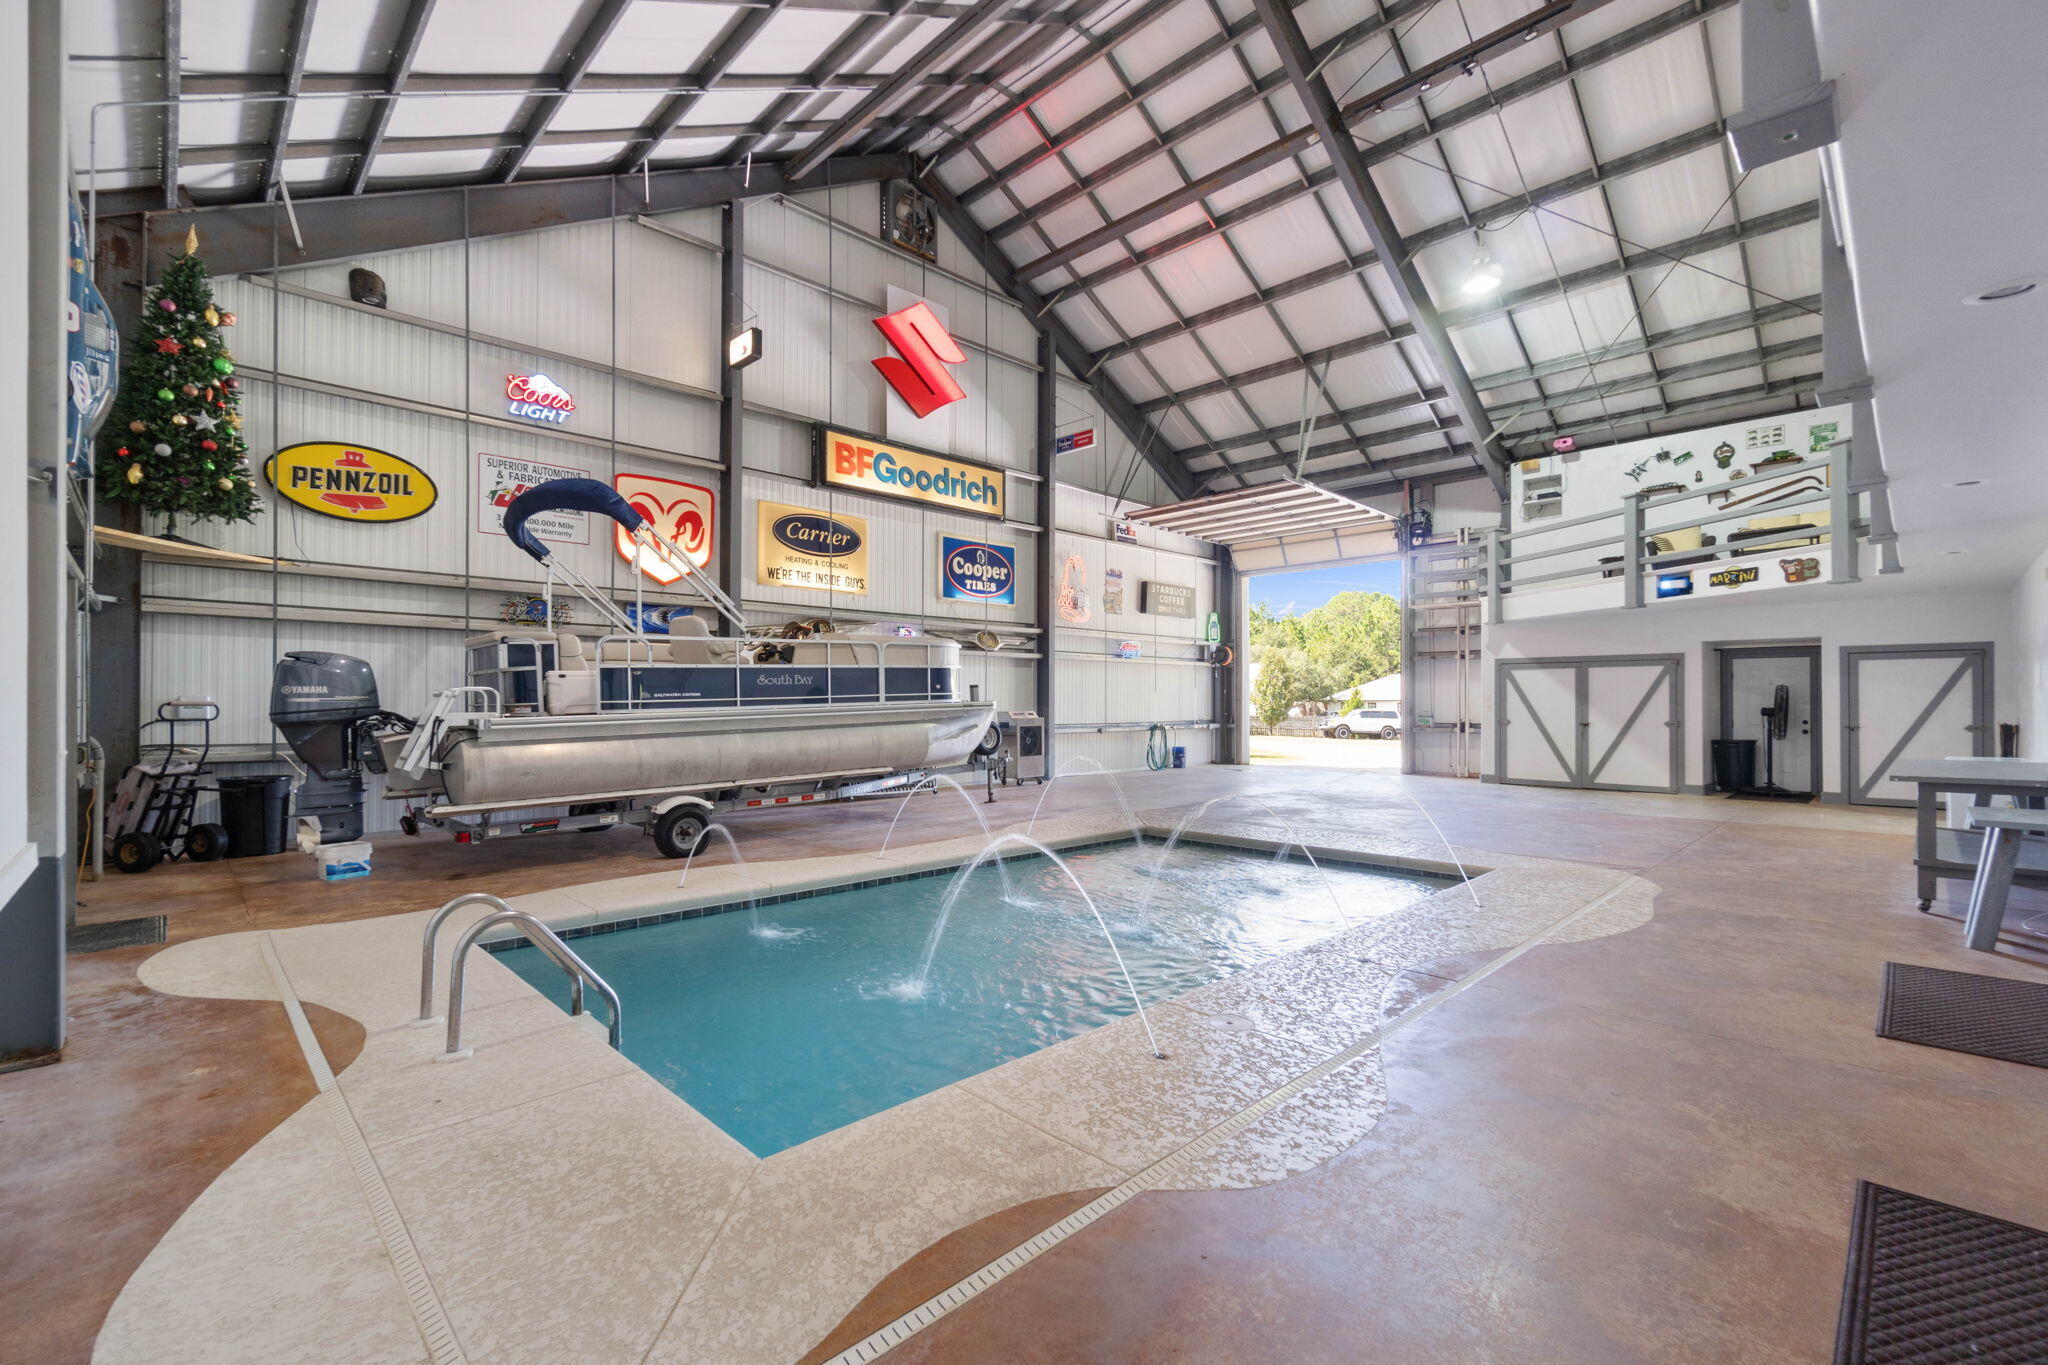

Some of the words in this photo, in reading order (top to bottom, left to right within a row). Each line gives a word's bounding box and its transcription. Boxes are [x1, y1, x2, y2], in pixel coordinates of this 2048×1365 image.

[507, 373, 576, 411] Coors
[509, 401, 572, 423] LIGHT
[487, 457, 529, 474] SUPERIOR
[532, 465, 582, 479] AUTOMOTIVE
[496, 470, 504, 479] &
[835, 440, 998, 507] BFGoodrich
[291, 465, 416, 496] PENNZOIL
[558, 521, 575, 530] Mile
[1116, 523, 1137, 537] FedEx
[541, 528, 573, 538] Warranty
[786, 522, 851, 546] Carrier
[785, 556, 813, 566] HEATING
[821, 560, 849, 570] COOLING
[952, 556, 1008, 581] Cooper
[767, 566, 793, 581] WE'RE
[796, 570, 812, 583] THE
[815, 573, 841, 587] INSDE
[964, 579, 997, 592] TIRES
[1151, 584, 1192, 597] STARBUCKS
[1159, 595, 1185, 606] COFFEE
[756, 674, 792, 686] South
[292, 685, 329, 694] YAMAHA
